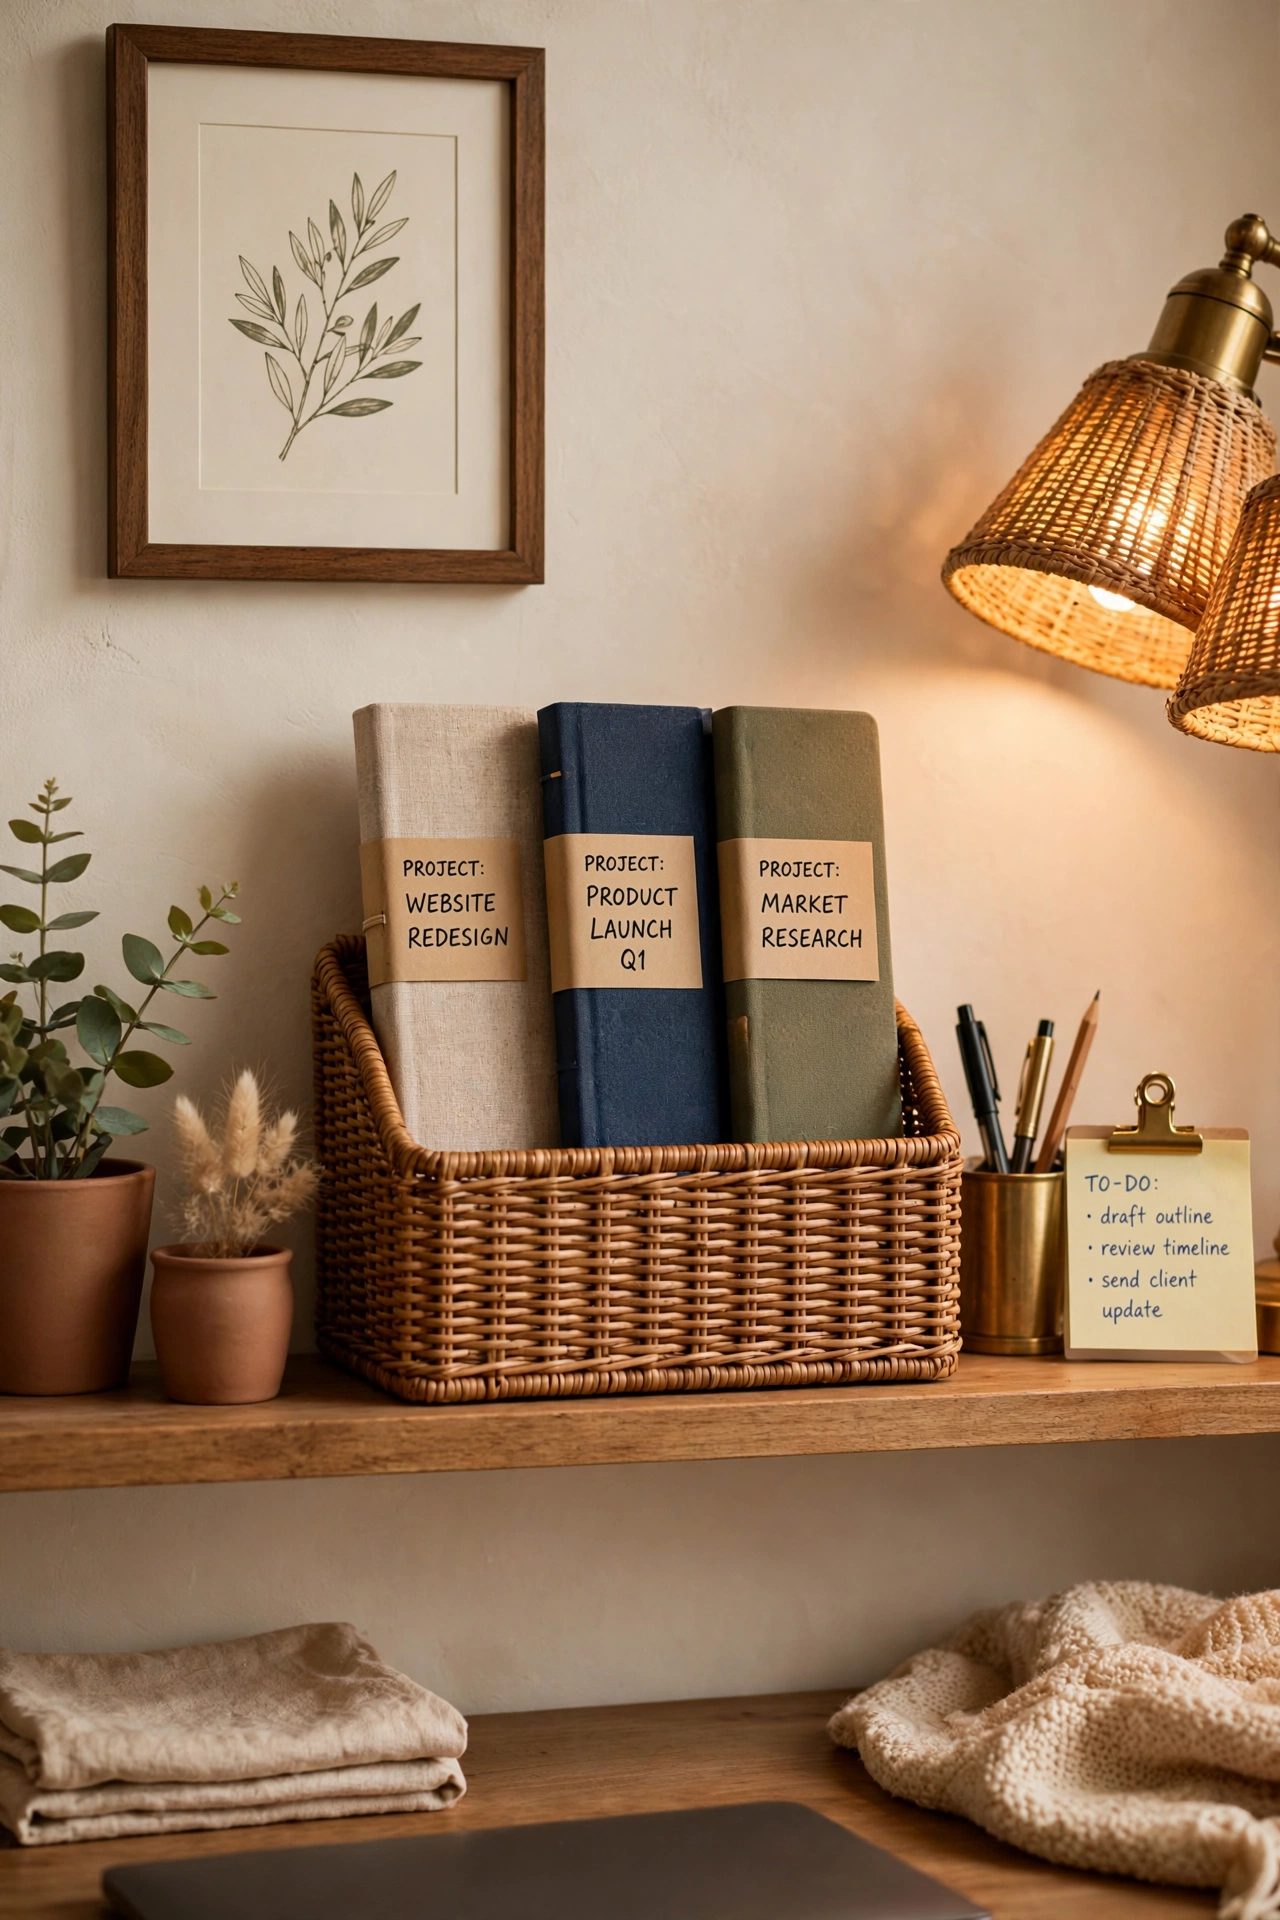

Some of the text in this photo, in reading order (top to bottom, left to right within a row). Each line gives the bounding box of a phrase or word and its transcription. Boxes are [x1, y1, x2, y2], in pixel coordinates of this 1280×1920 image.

[404, 860, 484, 876] PROJECT:
[585, 855, 663, 871] PROJECT:
[760, 860, 839, 878] PROJECT:
[406, 893, 495, 913] WEBSITE
[587, 885, 678, 906] PRODUCT
[762, 893, 848, 914] MARKET
[408, 927, 509, 948] REDESIGN
[591, 918, 671, 939] LAUNCH
[763, 927, 861, 948] RESEARCH
[621, 949, 644, 971] Q1
[1085, 1175, 1157, 1192] TO-DO:
[1101, 1204, 1213, 1227] draft outline
[1102, 1237, 1229, 1256] review timeline
[1102, 1269, 1197, 1288] send client
[1103, 1299, 1162, 1324] update
